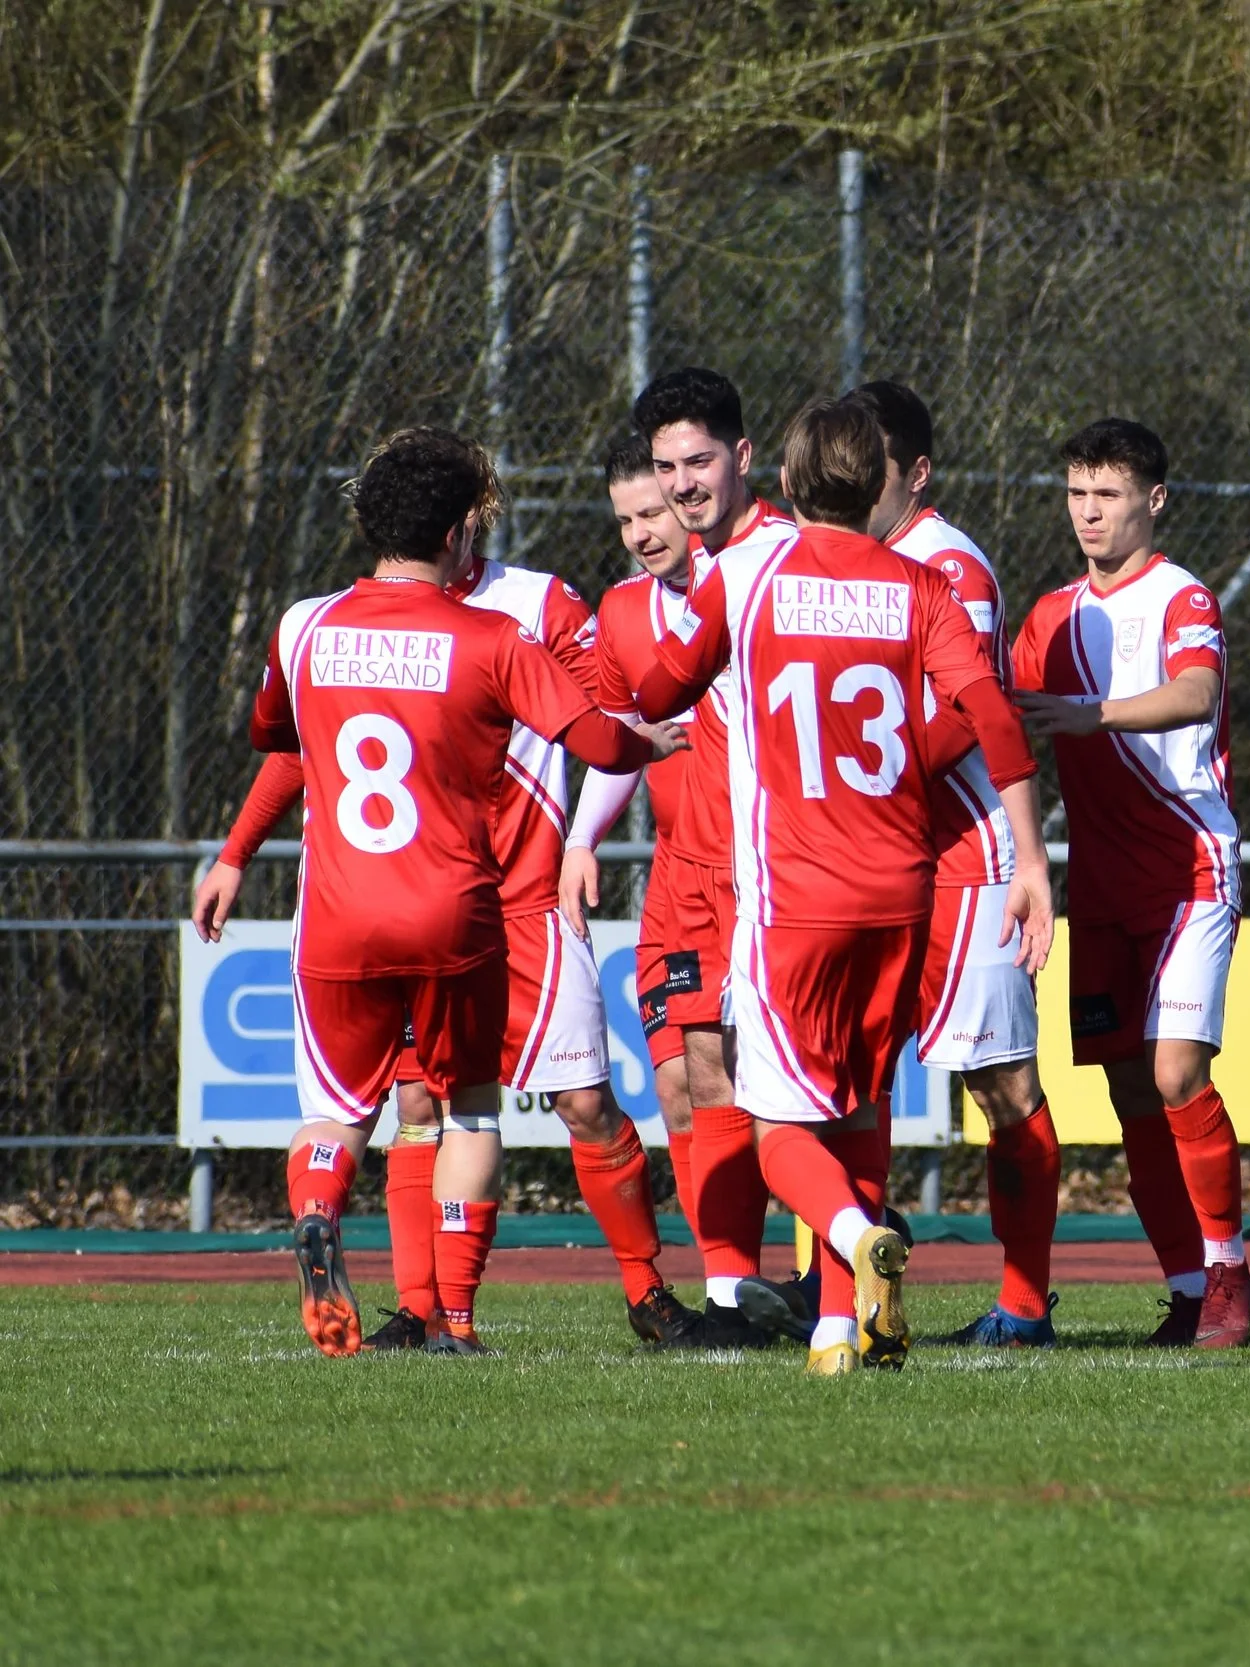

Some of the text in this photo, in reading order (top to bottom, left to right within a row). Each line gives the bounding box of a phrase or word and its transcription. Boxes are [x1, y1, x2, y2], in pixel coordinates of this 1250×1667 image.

[777, 580, 901, 609] LEHNER
[777, 608, 903, 636] VERSAND
[314, 631, 442, 660] LEHNER
[313, 659, 441, 688] VERSAND
[767, 661, 907, 799] 13
[335, 713, 419, 854] 8
[1156, 999, 1202, 1012] uhlsport
[952, 1031, 994, 1045] uhlsport
[550, 1047, 597, 1062] uhlsport
